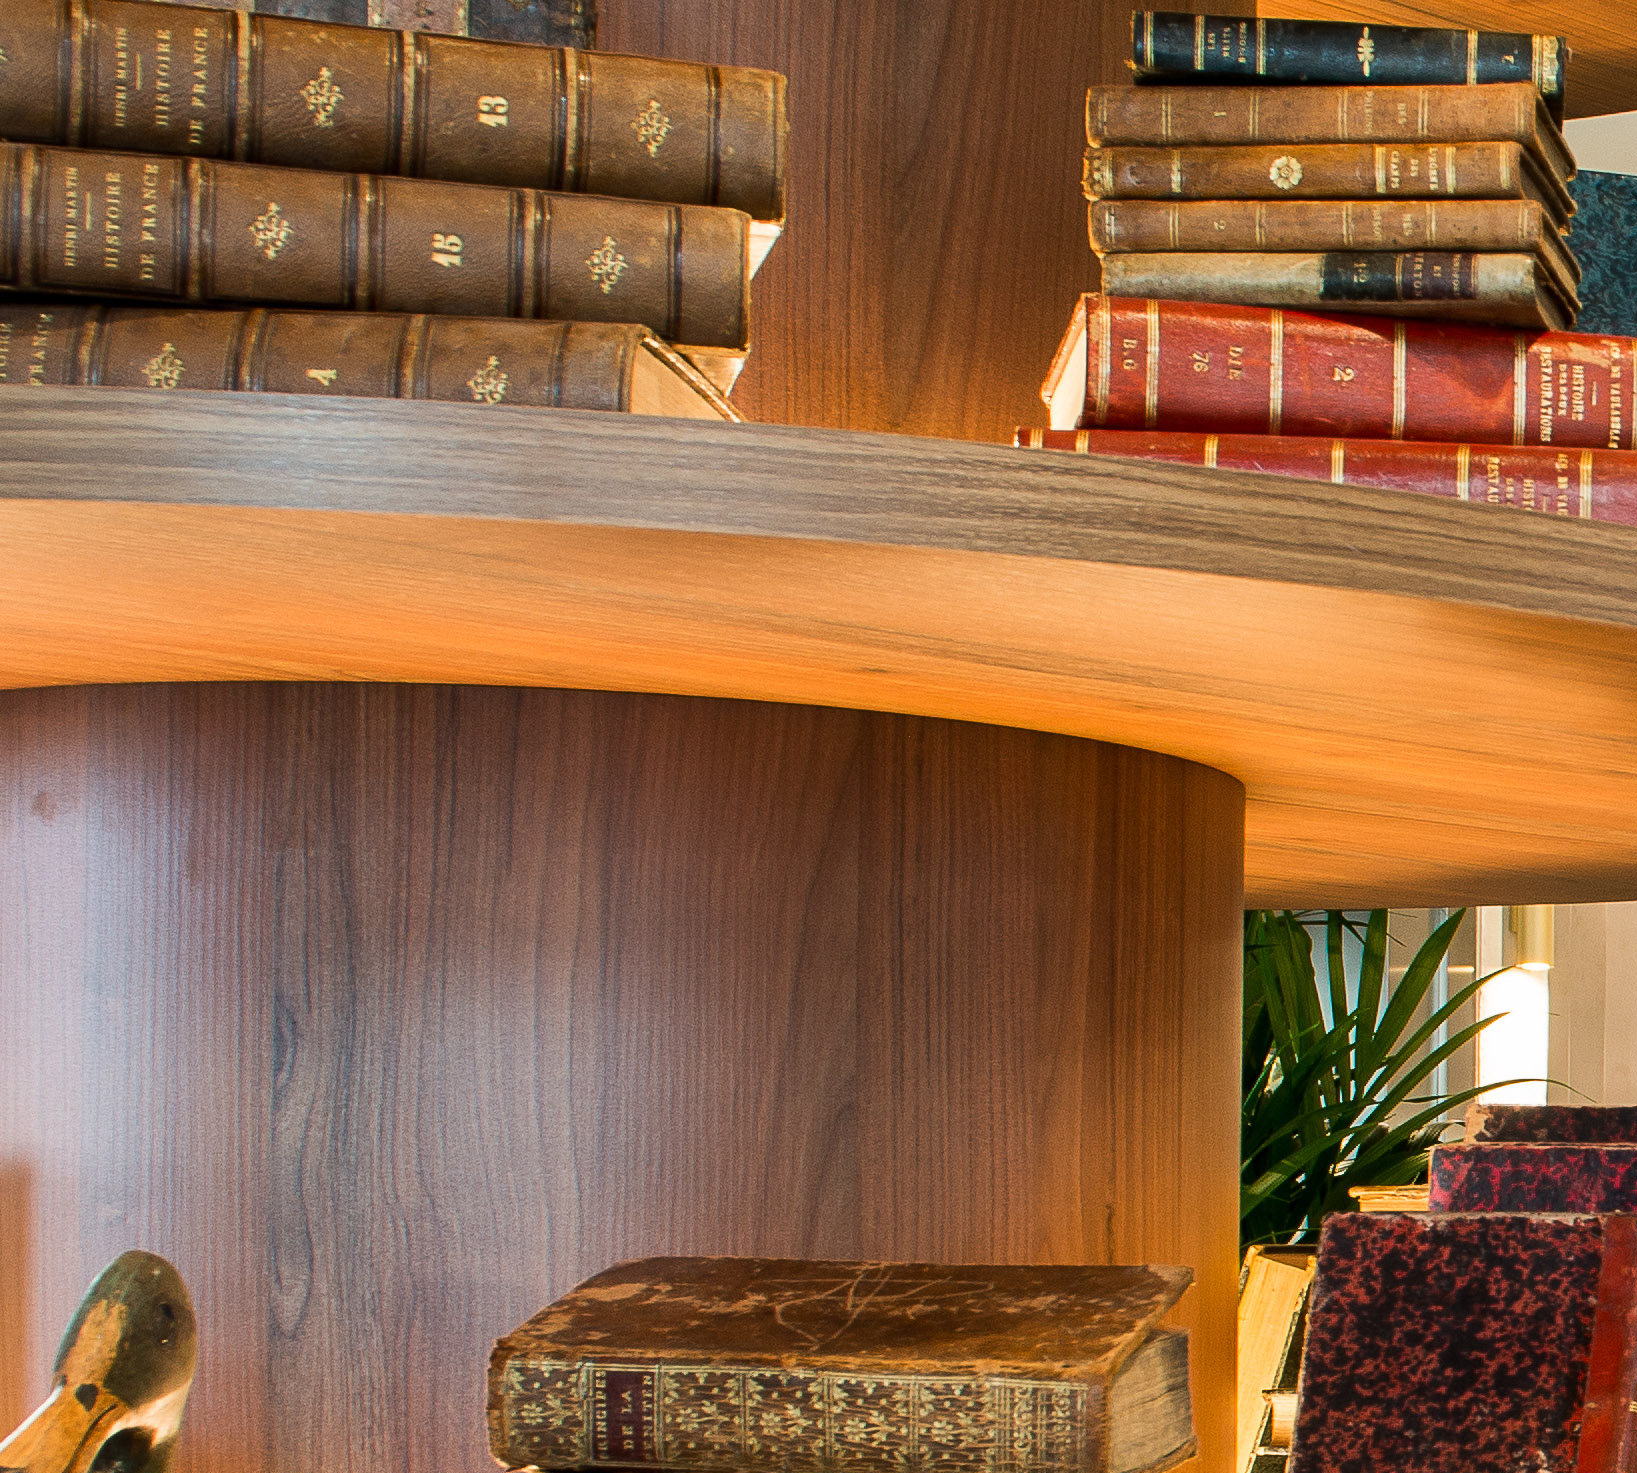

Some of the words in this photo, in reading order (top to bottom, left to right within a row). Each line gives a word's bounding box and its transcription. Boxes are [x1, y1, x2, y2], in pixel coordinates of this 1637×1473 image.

[114, 26, 129, 80] MARTIN
[190, 26, 209, 107] FRANCE
[154, 28, 172, 127] HISTOIRE
[187, 119, 205, 145] DE
[477, 95, 509, 128] 13
[64, 166, 80, 219] MARTIN
[141, 163, 159, 241] FRANCE
[104, 172, 122, 269] HISTOIRE
[63, 223, 79, 267] HENRI
[139, 253, 156, 280] DE
[431, 233, 463, 267] 15
[1332, 366, 1355, 384] 2
[1539, 345, 1553, 443] RESTAURATIONS
[1571, 364, 1585, 421] HISTOIRE
[620, 1390, 633, 1414] LA
[621, 1424, 635, 1450] DE
